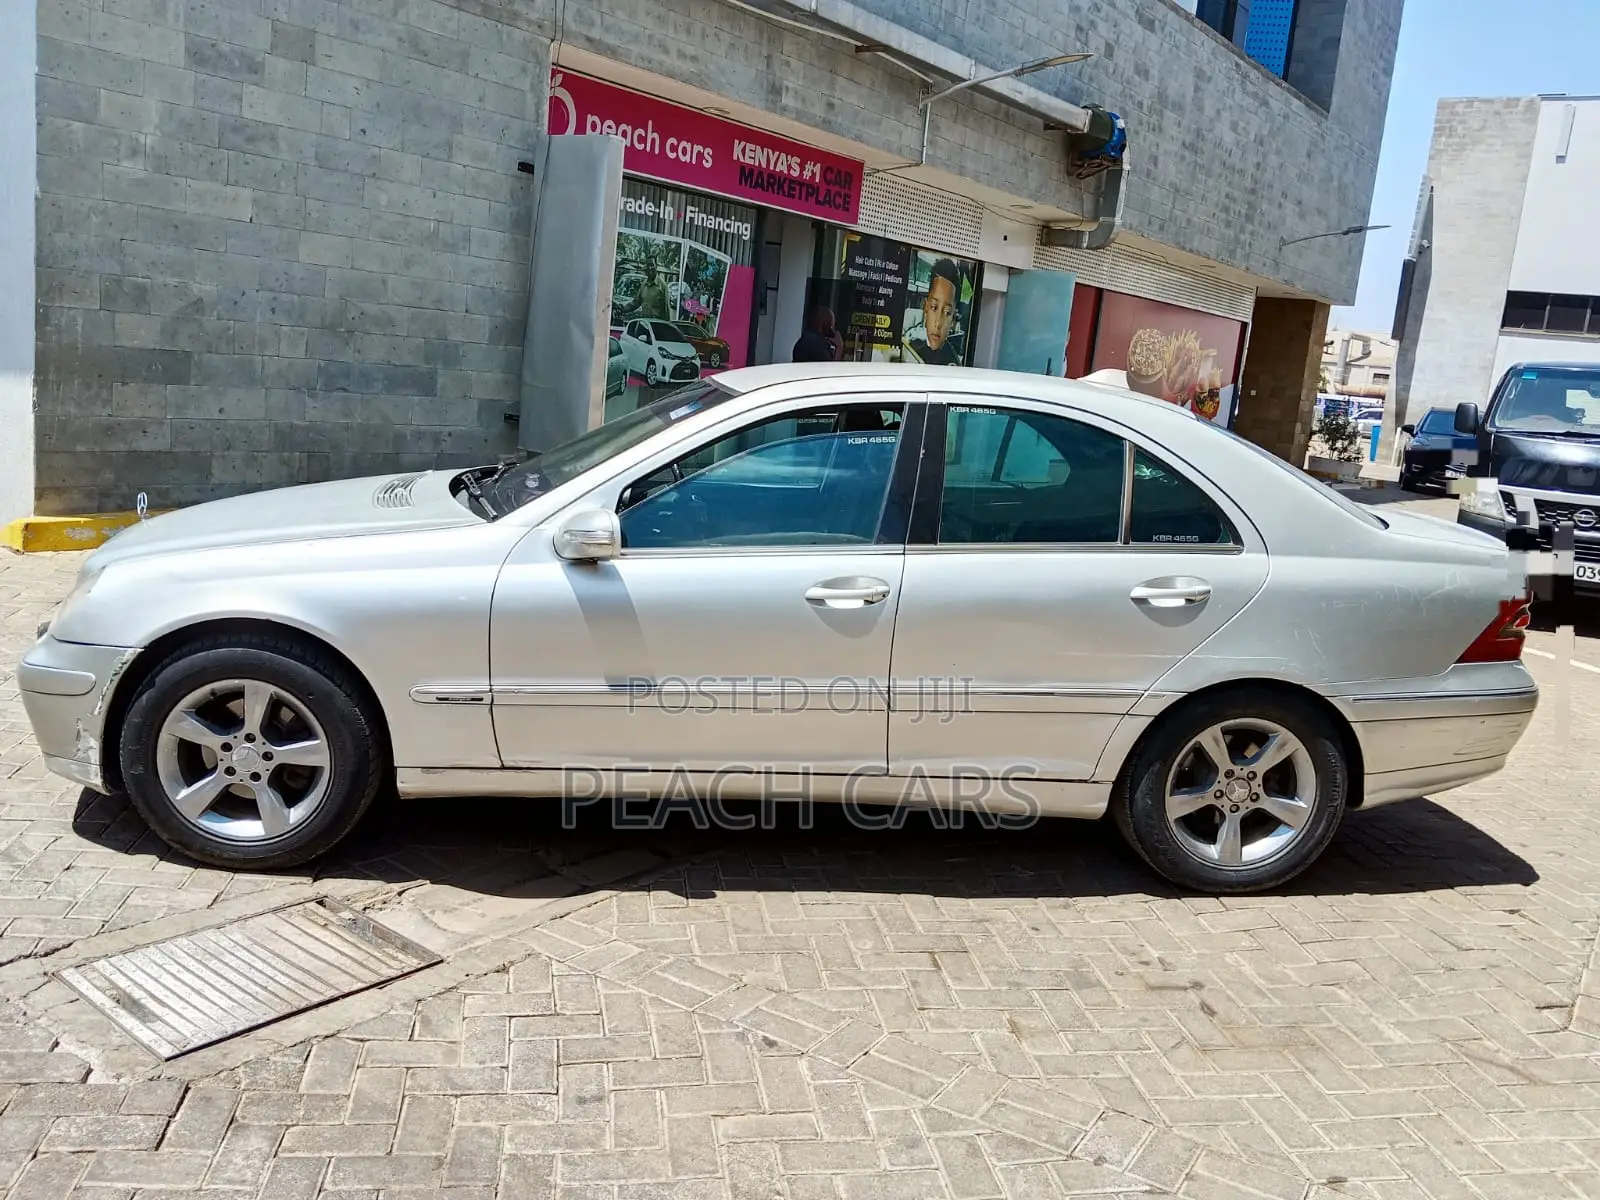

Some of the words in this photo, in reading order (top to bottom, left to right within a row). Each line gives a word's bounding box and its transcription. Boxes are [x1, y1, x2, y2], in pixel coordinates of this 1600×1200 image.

[586, 113, 660, 155] peach
[666, 137, 713, 169] cars
[733, 139, 802, 177] KENYA'S
[802, 160, 821, 183] #1
[823, 163, 854, 190] CAR
[738, 165, 852, 214] MARKETPLACE
[620, 195, 674, 221] rade-In
[685, 205, 751, 240] Financing
[855, 314, 870, 325] OPEN
[871, 316, 887, 326] DAILY
[950, 405, 970, 413] KBR
[847, 437, 868, 445] KBR
[1576, 565, 1600, 580] 03
